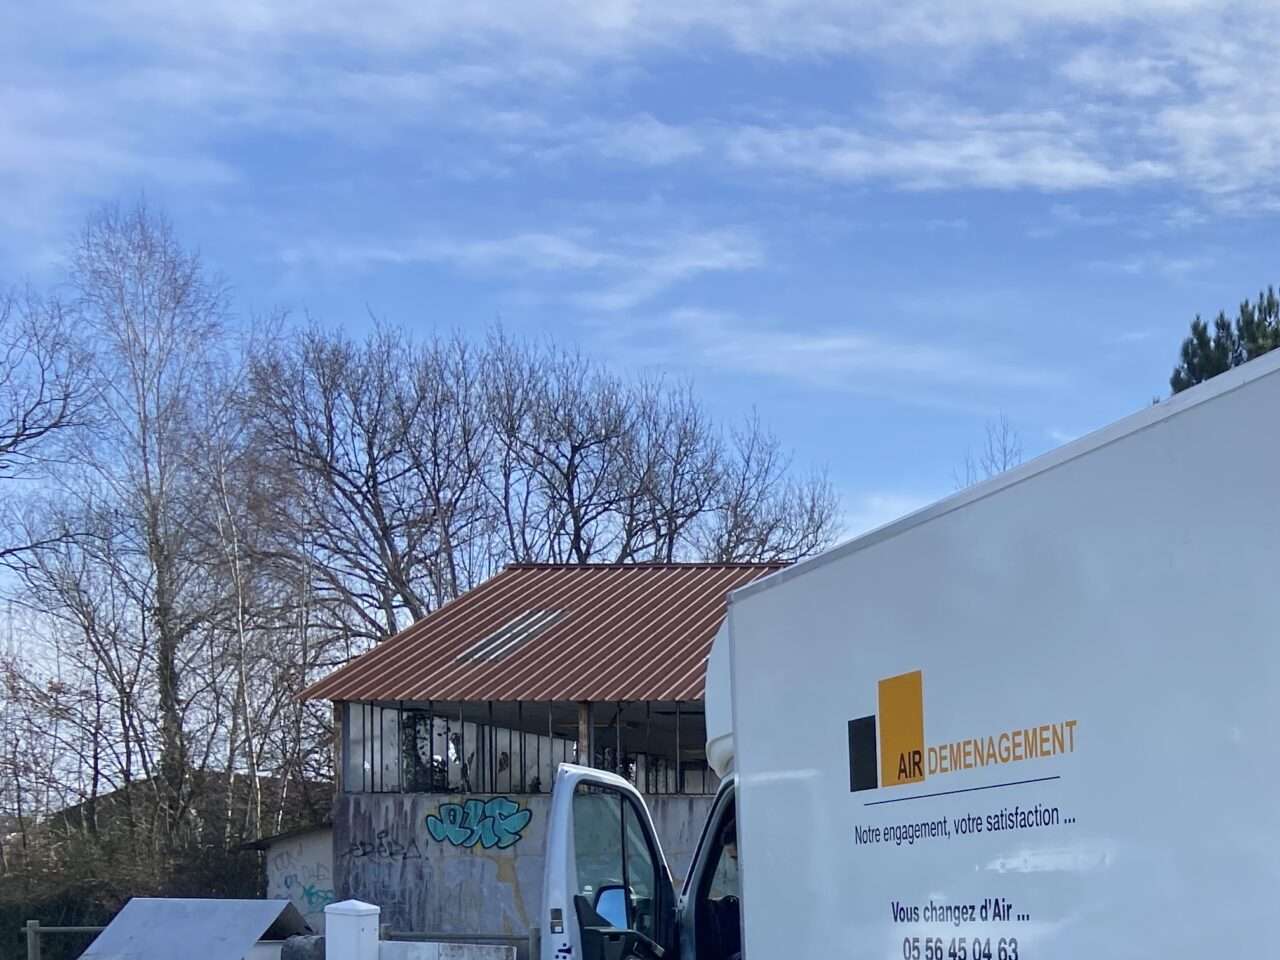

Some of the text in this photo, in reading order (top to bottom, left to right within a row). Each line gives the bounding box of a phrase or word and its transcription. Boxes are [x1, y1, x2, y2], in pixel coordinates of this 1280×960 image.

[855, 824, 881, 845] Notre
[883, 816, 951, 846] engagement,
[953, 812, 983, 835] votre
[891, 901, 920, 923] Vous
[923, 900, 976, 927] changez
